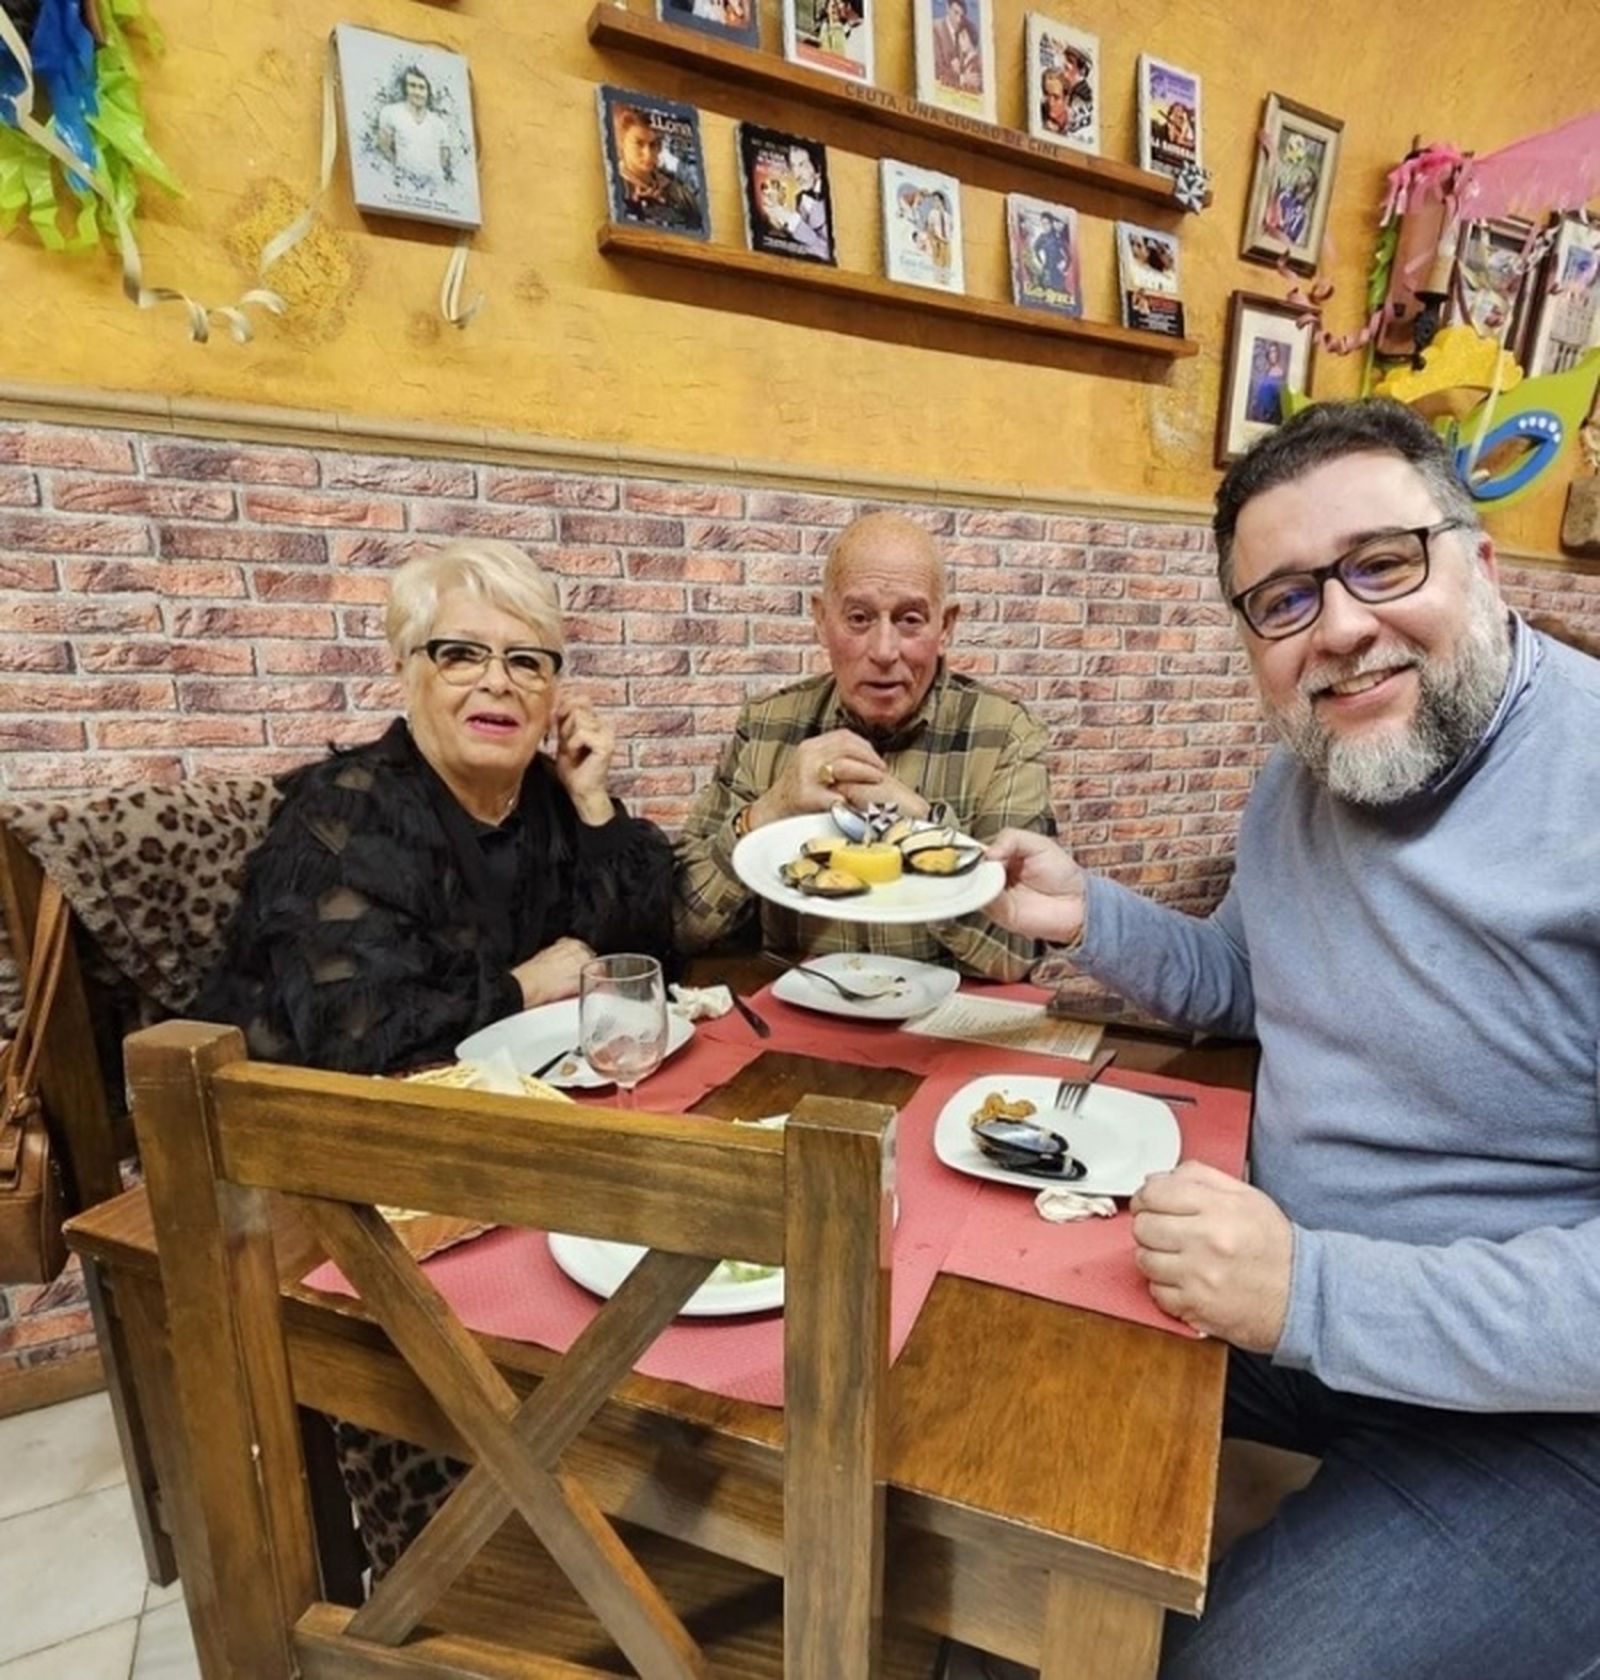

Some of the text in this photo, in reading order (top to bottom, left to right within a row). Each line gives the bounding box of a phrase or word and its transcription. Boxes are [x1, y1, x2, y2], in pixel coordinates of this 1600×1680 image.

[844, 84, 902, 111] CEUTA,
[907, 101, 939, 120] UNA
[944, 115, 1000, 140] CIUDAD
[1027, 138, 1059, 158] CINE
